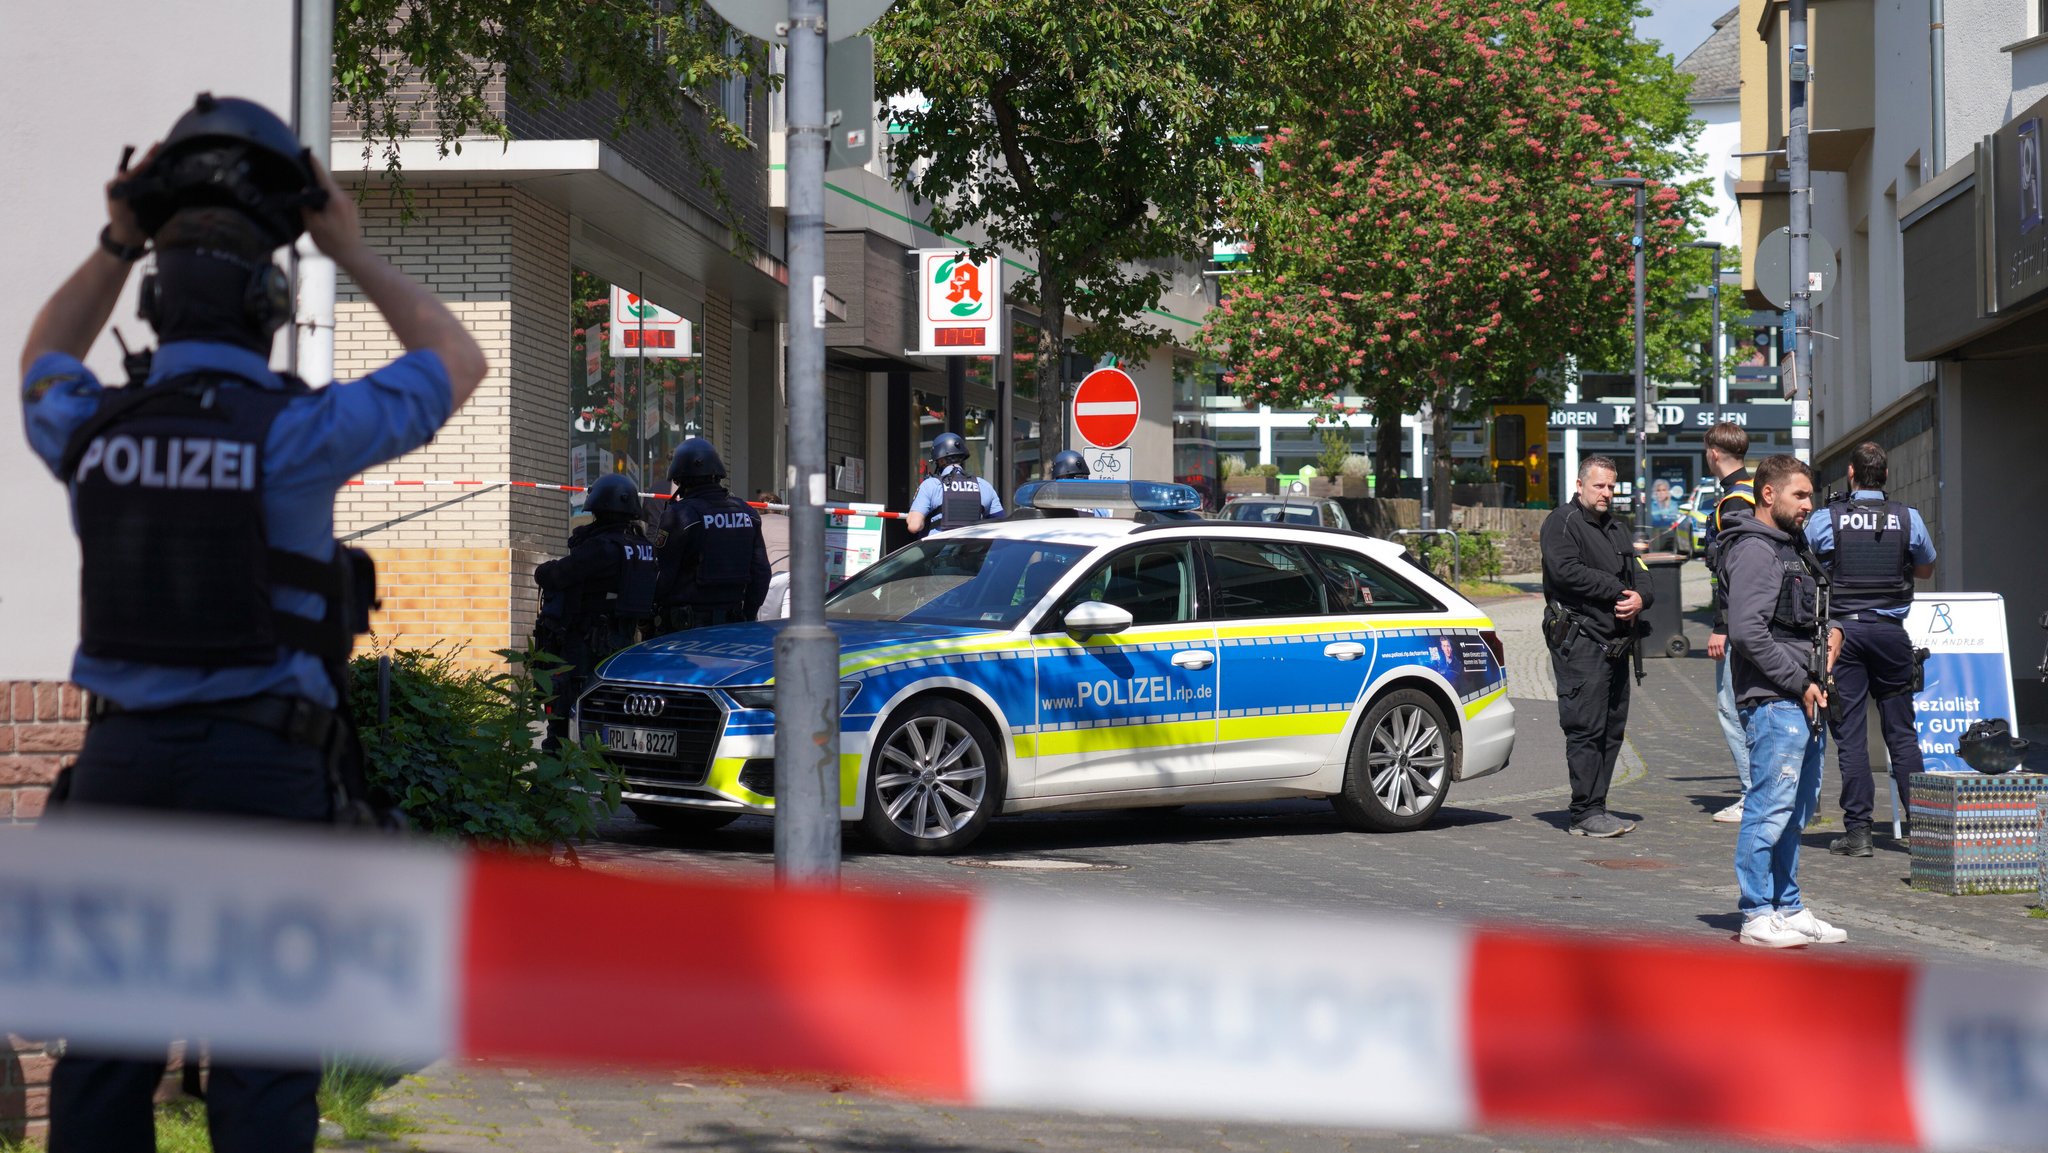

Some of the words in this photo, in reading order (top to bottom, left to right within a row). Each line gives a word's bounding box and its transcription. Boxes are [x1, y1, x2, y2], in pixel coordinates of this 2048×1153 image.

[1612, 405, 1685, 425] KND
[76, 434, 257, 491] POLIZEI
[1839, 513, 1901, 530] POLIEI
[1042, 676, 1213, 711] www.POLIZEI.rlp.de
[609, 729, 628, 750] RPL
[631, 731, 637, 751] 4
[646, 732, 676, 754] 8227
